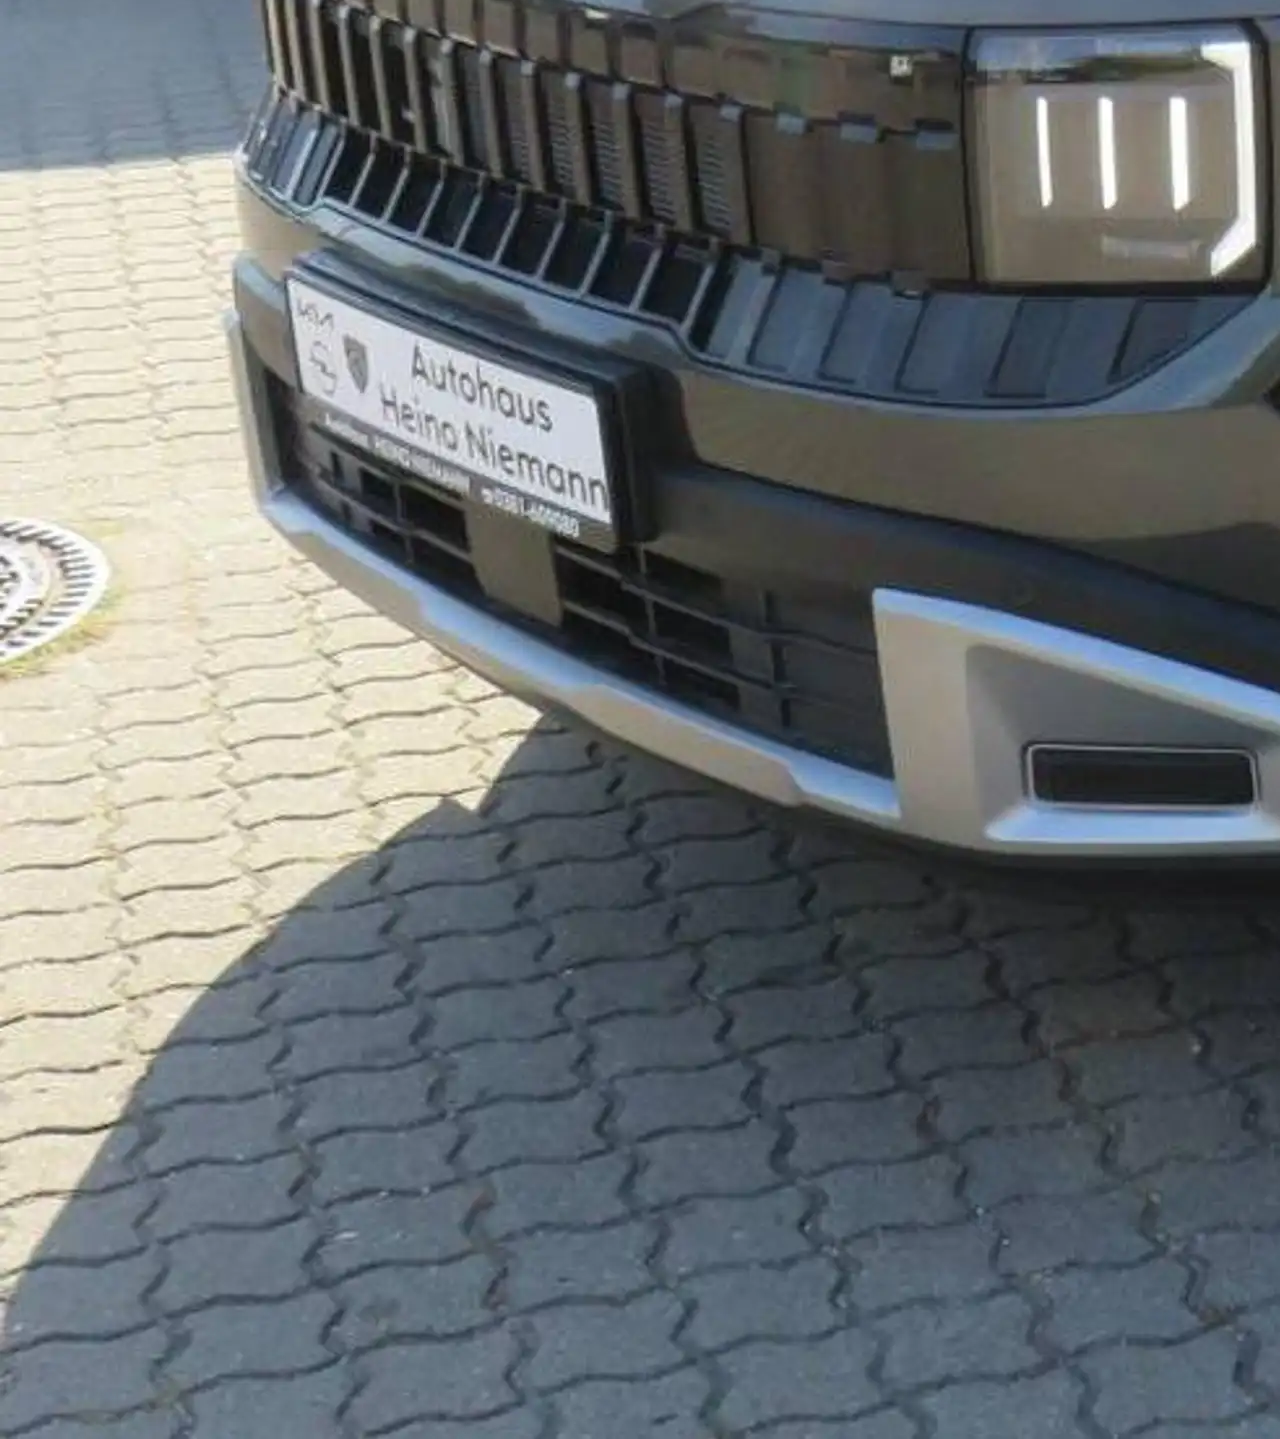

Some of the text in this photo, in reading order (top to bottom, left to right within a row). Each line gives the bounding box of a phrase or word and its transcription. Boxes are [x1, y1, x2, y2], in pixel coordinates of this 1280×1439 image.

[380, 374, 459, 451] Heino
[465, 420, 608, 506] Niemann
[411, 340, 553, 432] Autohaus
